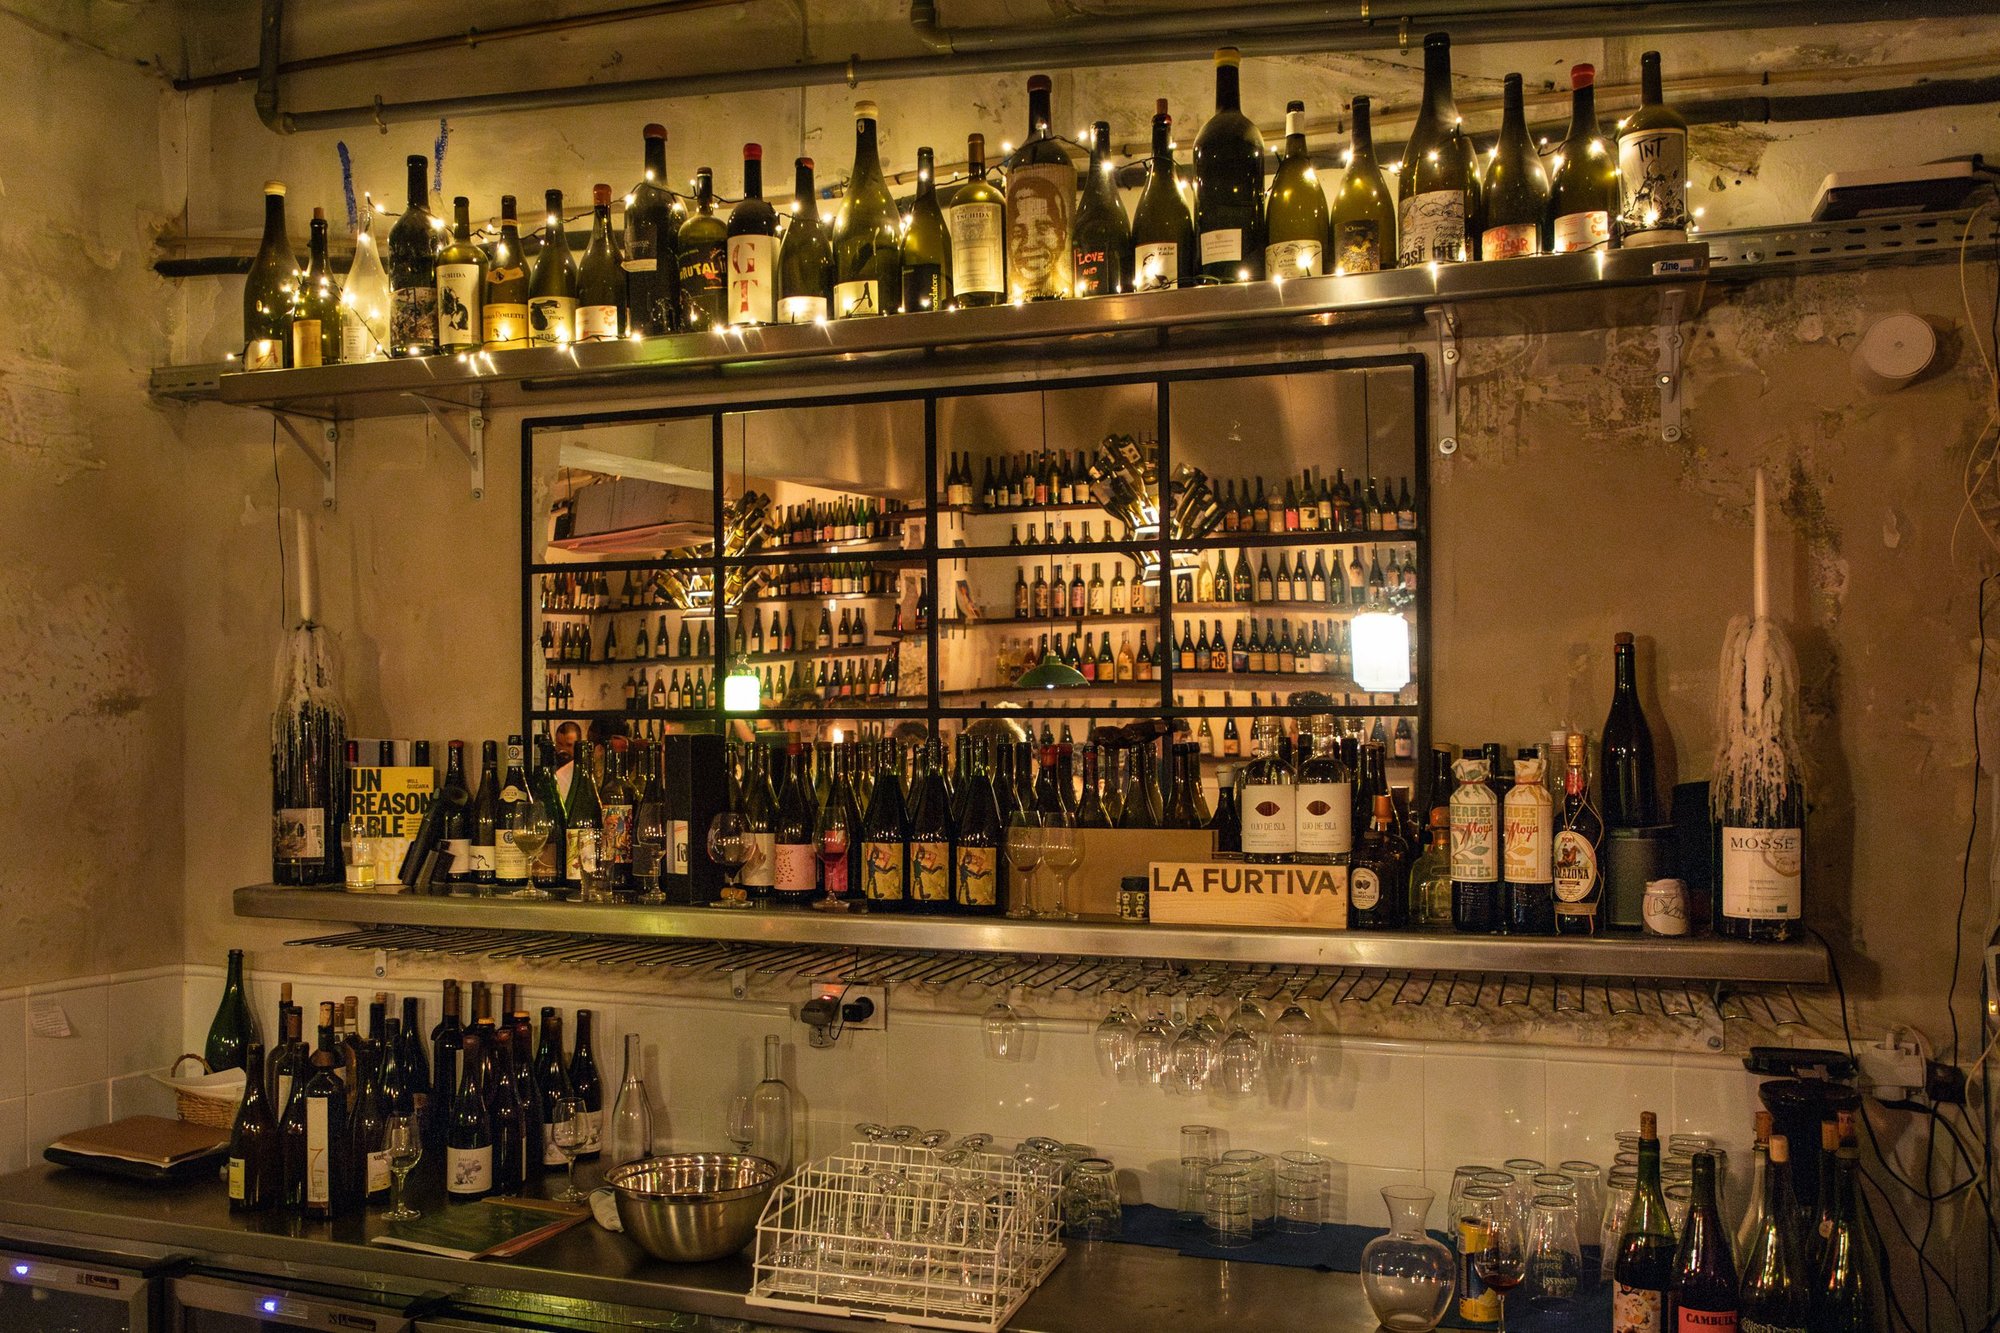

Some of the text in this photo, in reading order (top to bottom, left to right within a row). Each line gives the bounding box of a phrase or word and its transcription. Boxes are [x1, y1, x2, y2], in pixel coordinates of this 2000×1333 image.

[1632, 136, 1667, 162] TNT
[956, 211, 990, 220] TSCHIDA
[733, 243, 755, 273] G
[1077, 251, 1104, 265] LOVE
[1661, 262, 1679, 270] Zine
[733, 280, 758, 313] T
[352, 769, 381, 792] UN
[352, 793, 434, 815] REASON
[353, 816, 404, 837] ABLE
[1460, 821, 1493, 845] Moya
[1507, 822, 1538, 845] Moya
[1731, 836, 1794, 850] MOSSE
[1154, 868, 1339, 896] LA FURTIVA
